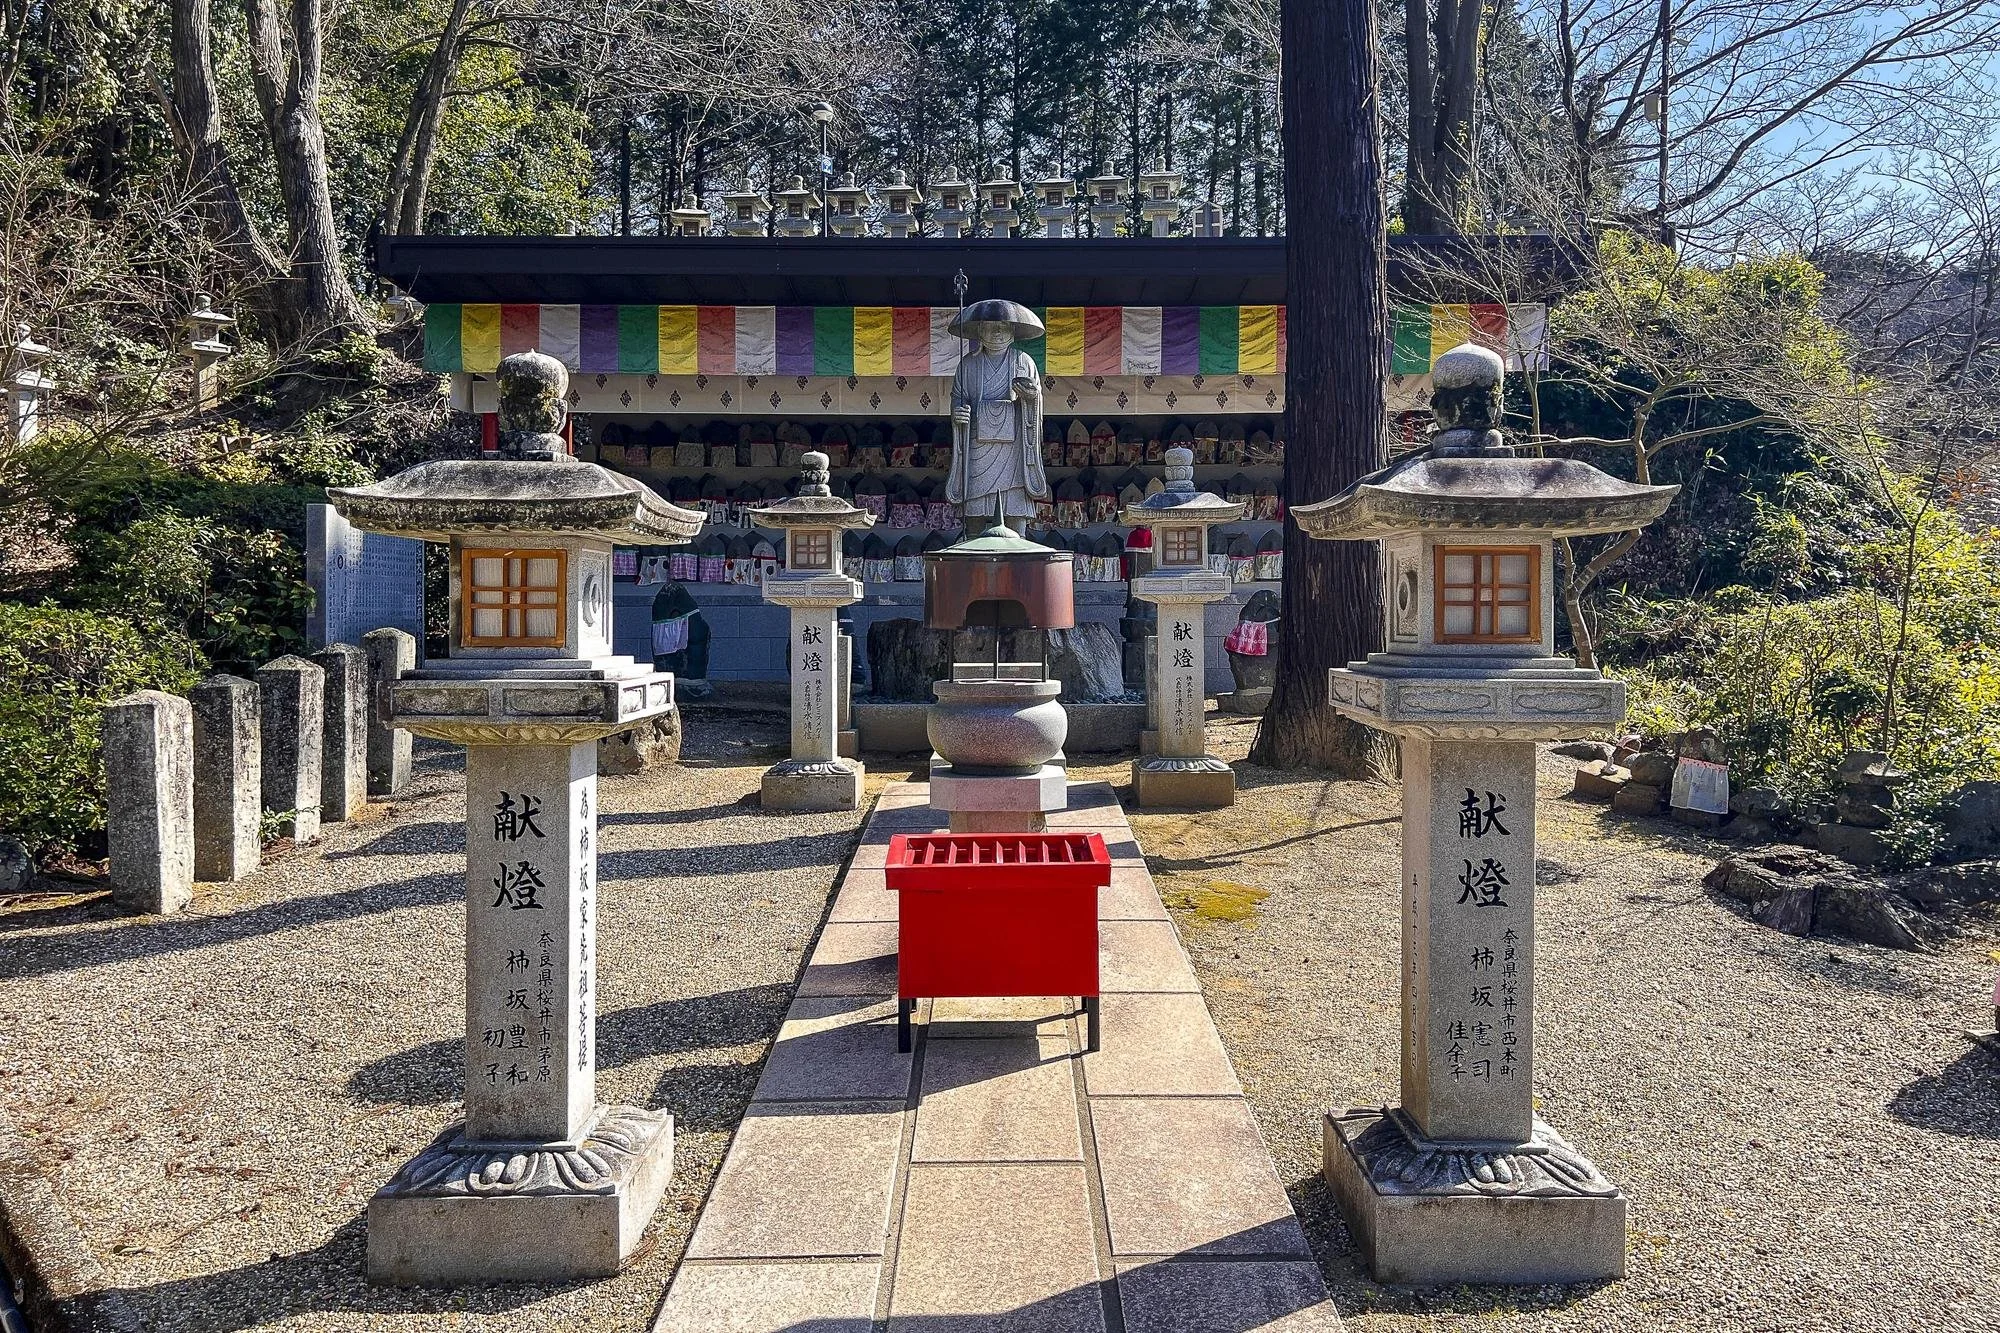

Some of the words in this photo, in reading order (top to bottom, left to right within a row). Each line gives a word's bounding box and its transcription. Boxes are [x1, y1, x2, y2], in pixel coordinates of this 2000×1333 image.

[802, 625, 823, 672] 献燈
[1173, 621, 1194, 668] 献燈
[492, 790, 546, 911] 献燈
[1456, 787, 1511, 908] 献燈
[482, 1025, 506, 1087] 初子
[535, 929, 555, 1083] 奈良県桜井市茅原
[1500, 928, 1520, 1081] 奈良県桜井市西本町
